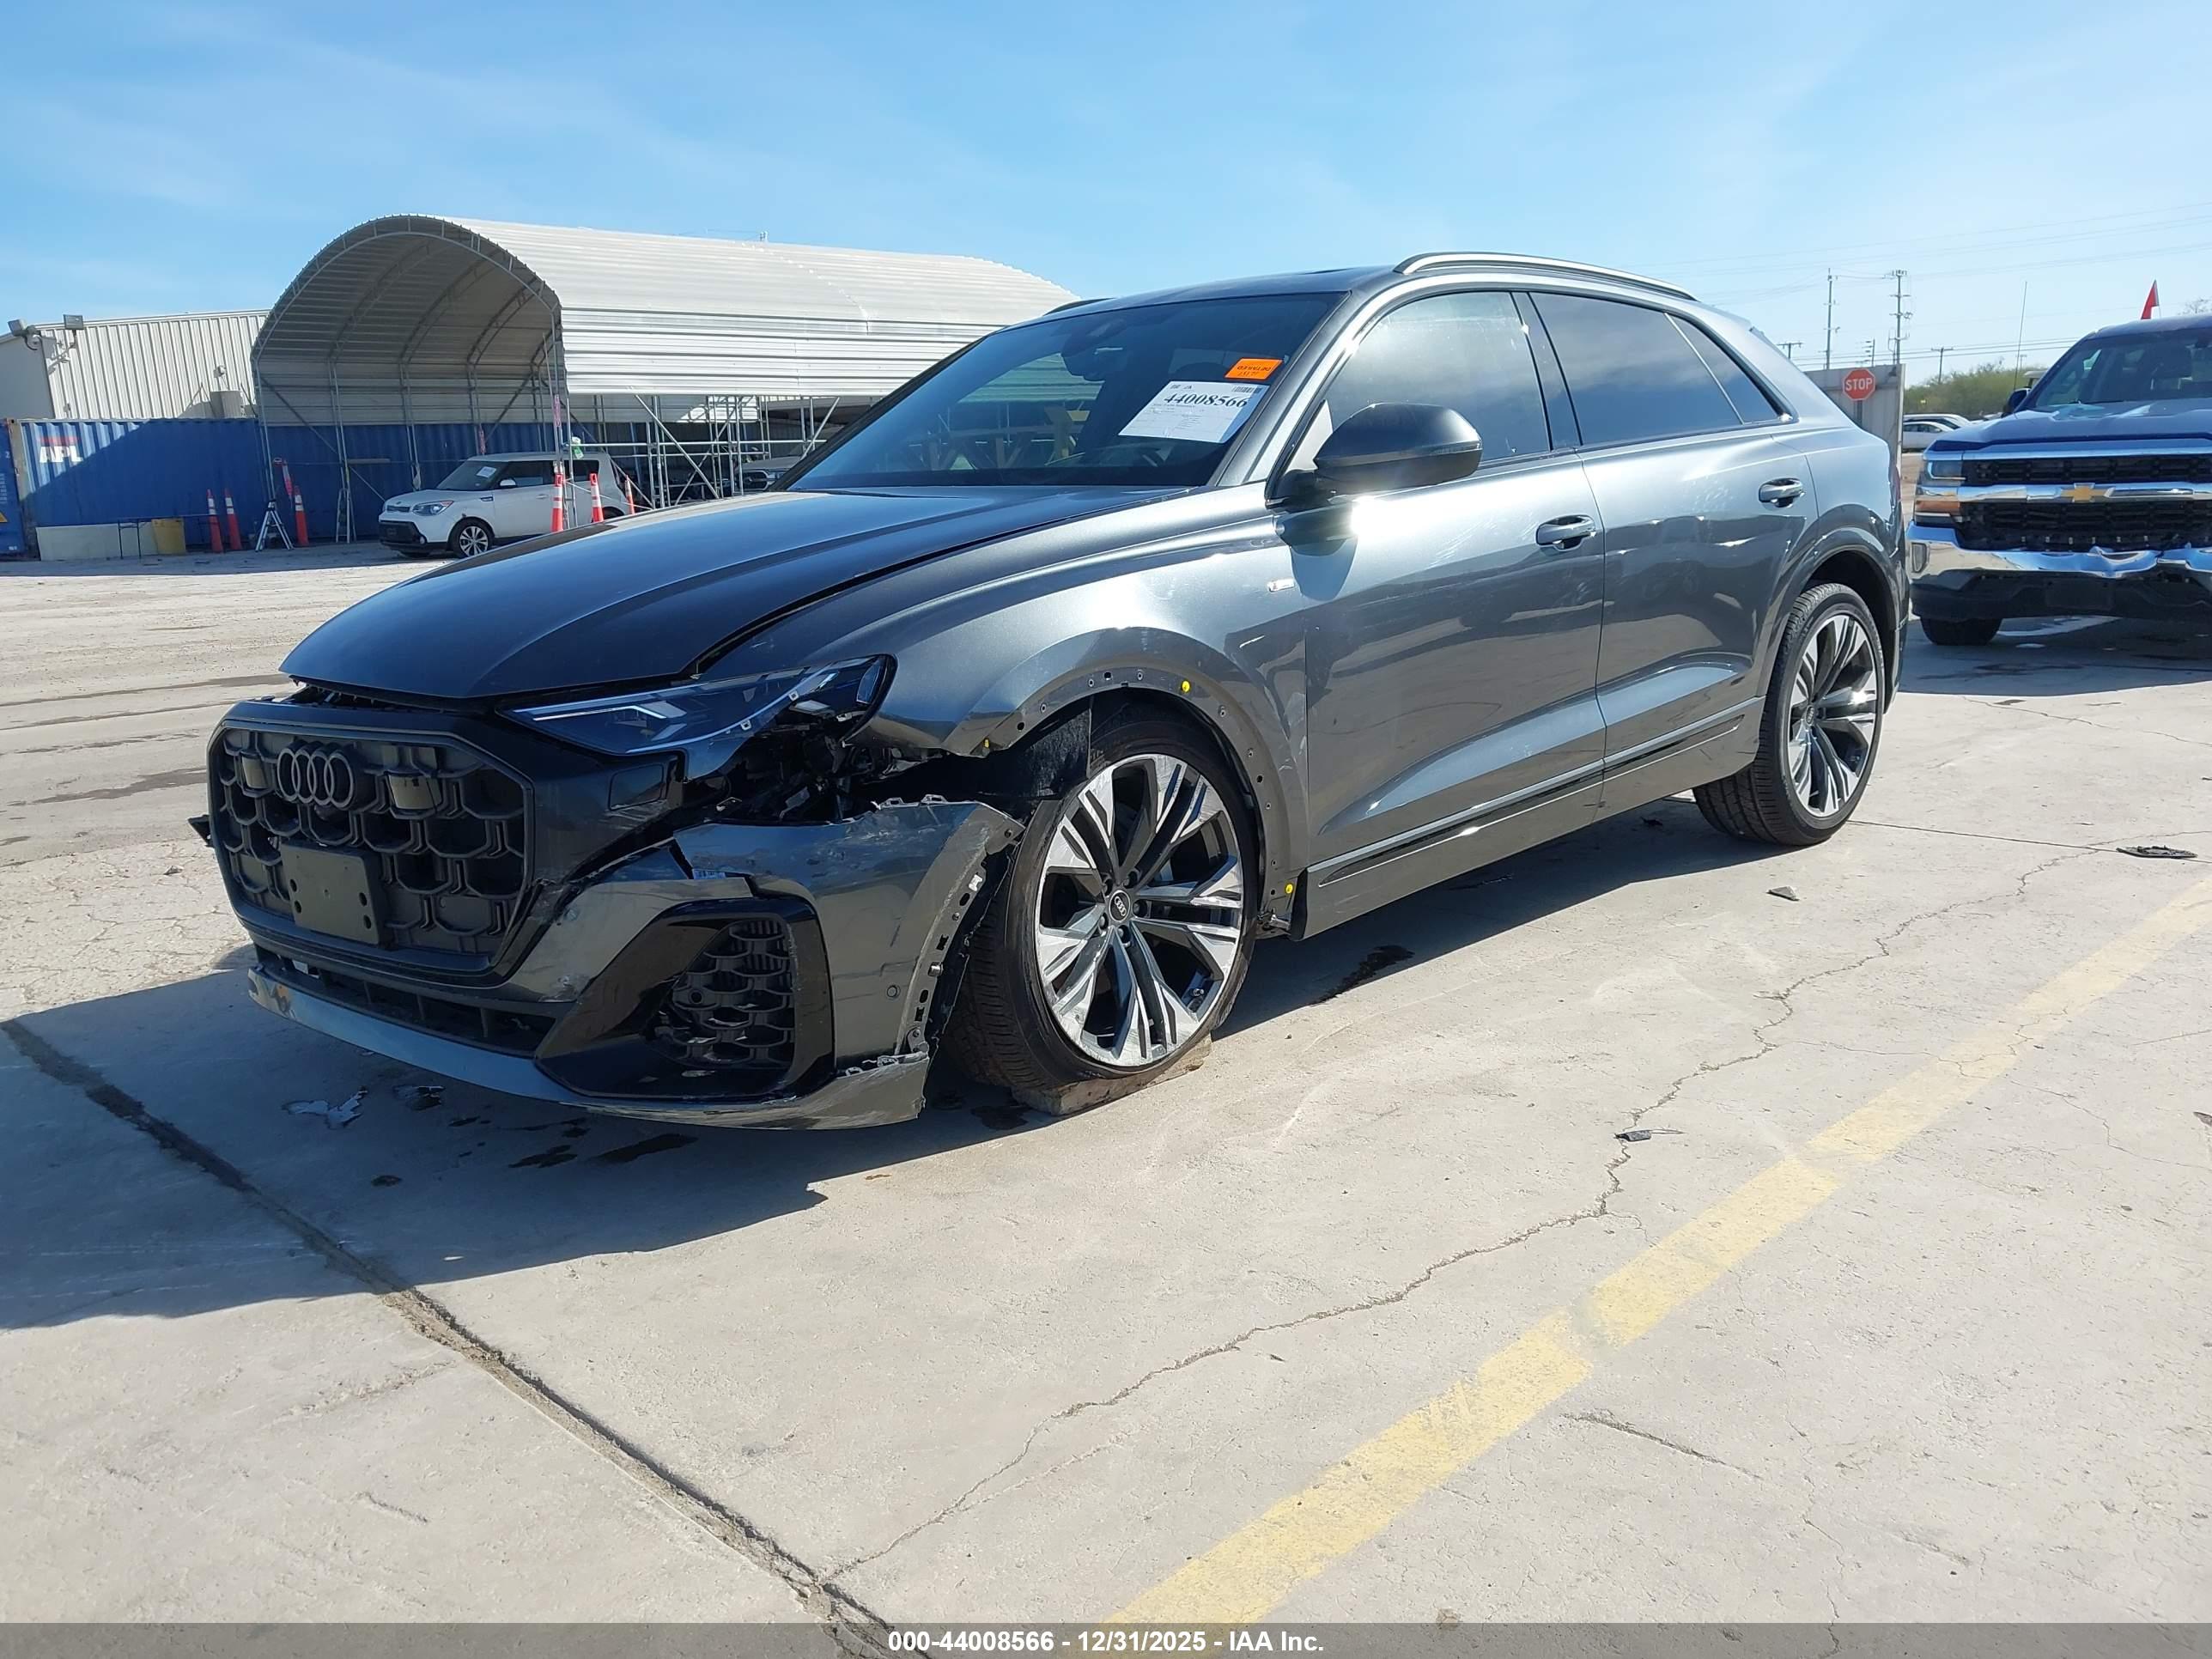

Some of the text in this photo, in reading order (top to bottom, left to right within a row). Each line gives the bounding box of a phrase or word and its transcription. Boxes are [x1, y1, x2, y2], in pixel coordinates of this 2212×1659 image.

[1845, 378, 1873, 392] STOP
[1164, 392, 1250, 408] 44008566
[40, 446, 83, 463] APL
